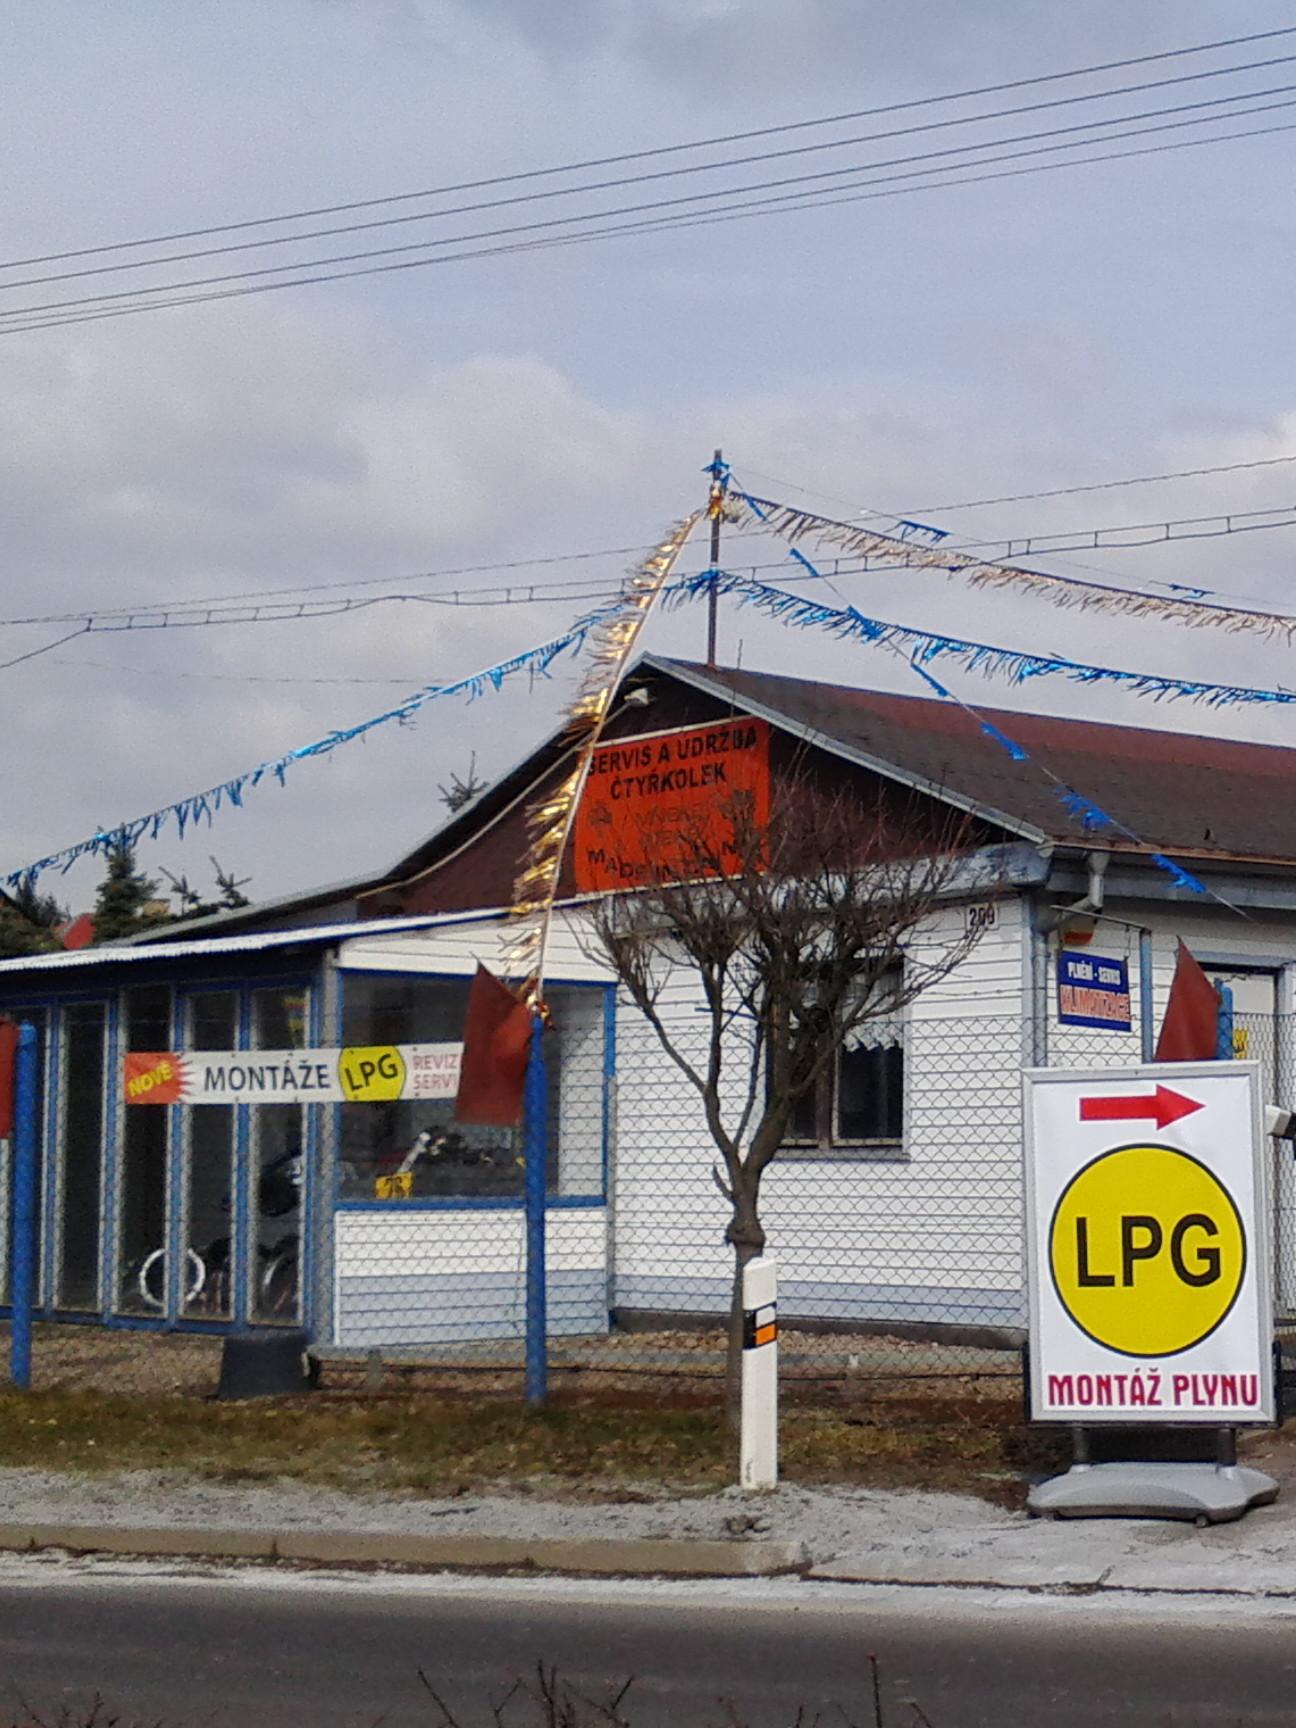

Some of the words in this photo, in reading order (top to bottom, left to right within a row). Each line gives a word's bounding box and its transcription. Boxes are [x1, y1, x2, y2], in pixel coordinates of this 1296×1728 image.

[658, 746, 670, 764] A
[204, 1061, 331, 1092] MONTÁŽE
[345, 1053, 399, 1091] LPG
[413, 1054, 458, 1069] REVIZ
[413, 1073, 457, 1089] SERVI
[1076, 1213, 1221, 1287] LPG
[1048, 1367, 1162, 1406] MONTÁŽ
[1172, 1374, 1258, 1406] PLYNU
